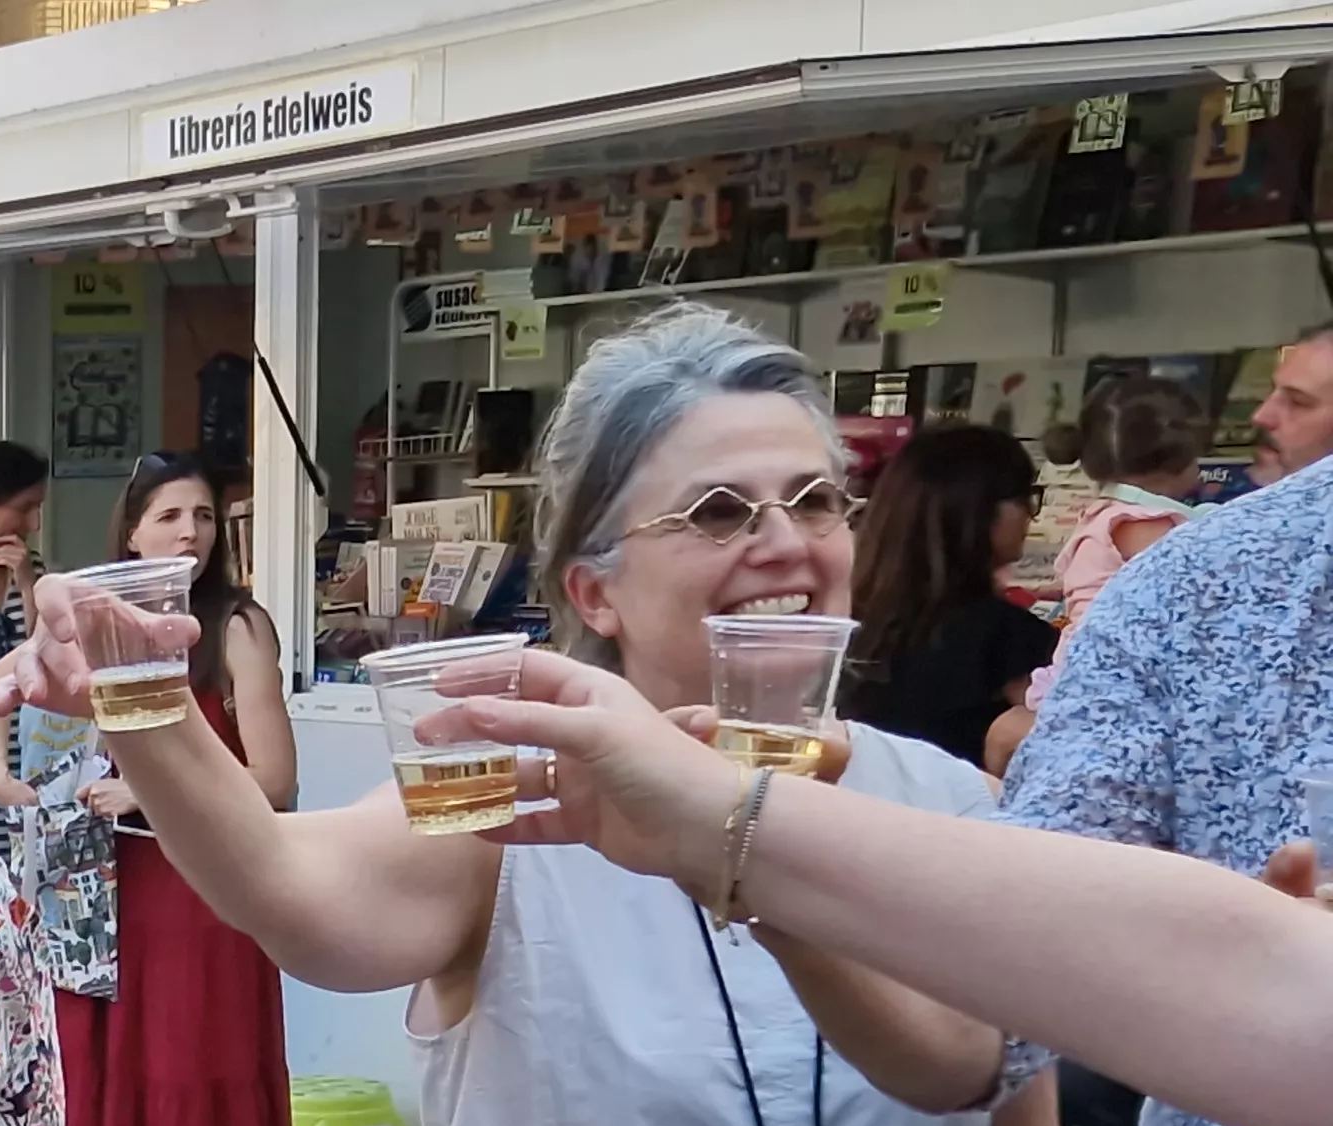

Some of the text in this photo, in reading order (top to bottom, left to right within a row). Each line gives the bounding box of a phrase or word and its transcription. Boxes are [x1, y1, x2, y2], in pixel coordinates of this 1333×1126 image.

[168, 82, 374, 159] Librería Edelweis
[904, 274, 920, 294] 10
